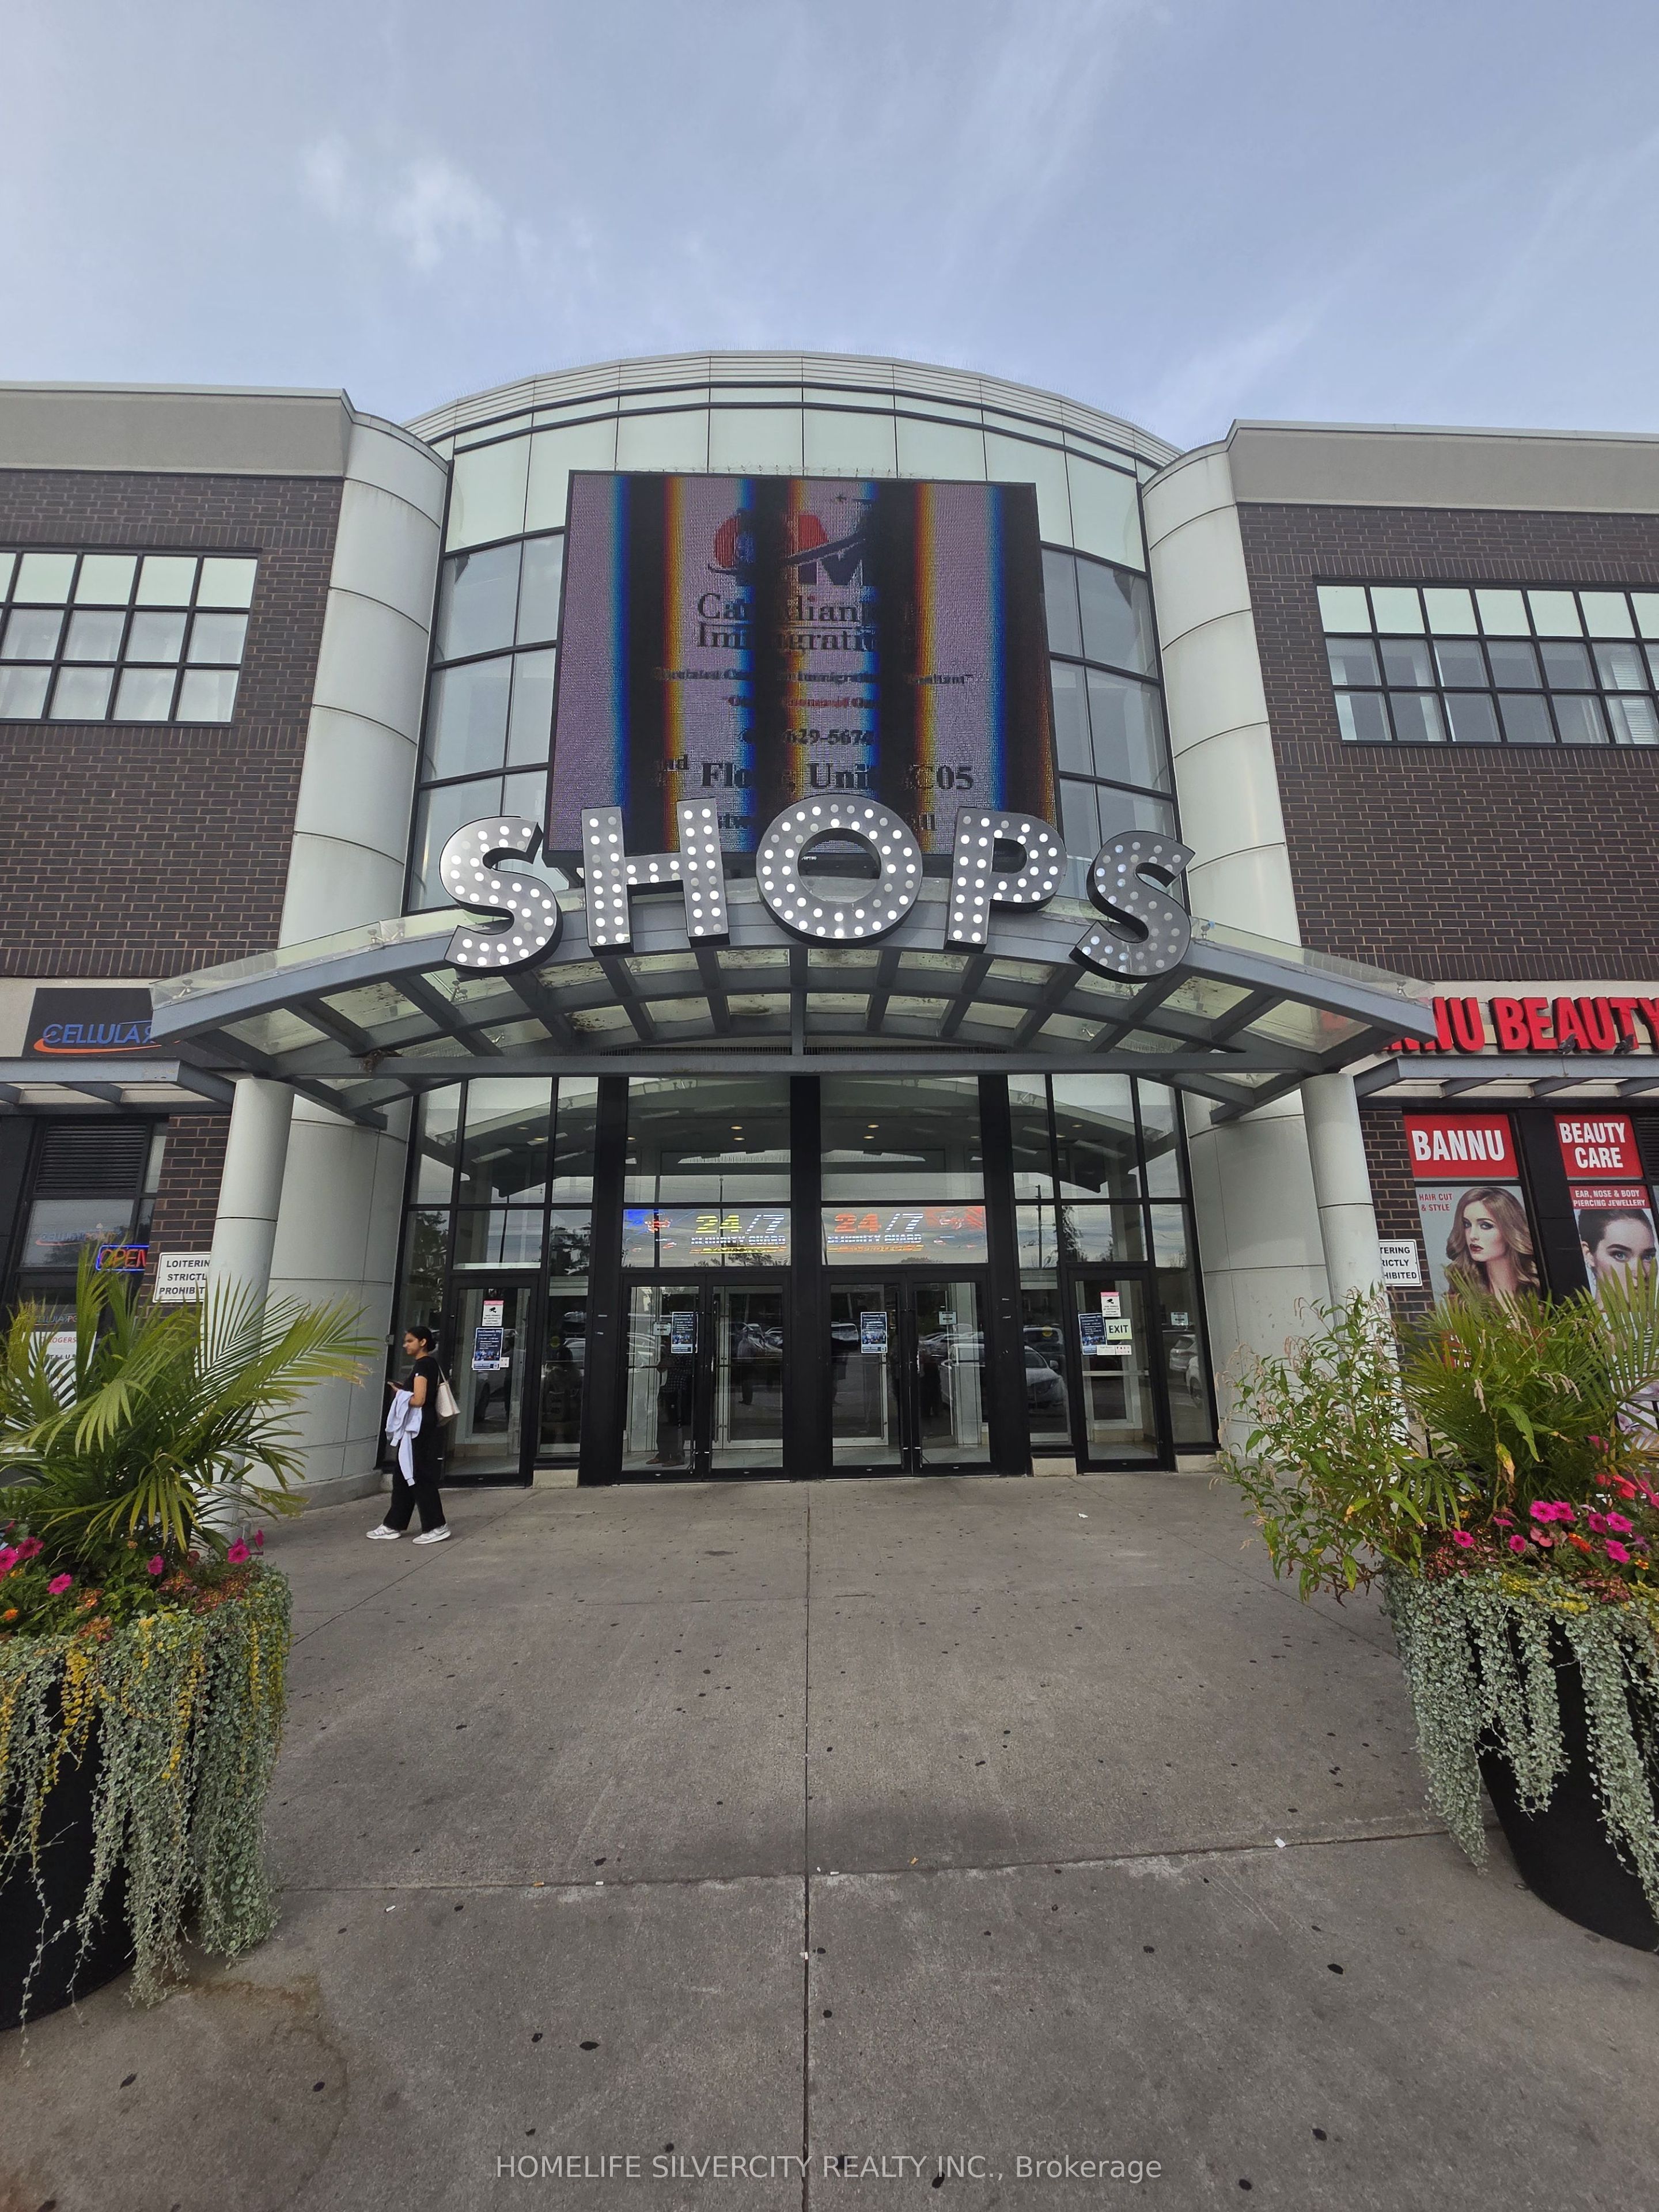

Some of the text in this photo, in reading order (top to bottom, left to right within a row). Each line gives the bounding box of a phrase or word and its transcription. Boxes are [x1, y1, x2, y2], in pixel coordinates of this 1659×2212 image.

[439, 794, 1196, 983] SHOPS
[1559, 1122, 1626, 1143] BEAUTY
[1411, 1130, 1505, 1161] BANNU
[1574, 1146, 1623, 1168] CARE
[1419, 1193, 1453, 1201] HAIR CUT
[1573, 1199, 1646, 1207] PIERCING JEWELLERY
[1574, 1190, 1639, 1199] EAR, NOSE & BODY
[1421, 1203, 1450, 1212] & STYLE
[695, 1214, 785, 1234] 24/7
[834, 1213, 923, 1233] 24/7
[100, 1248, 147, 1268] OPEN
[166, 1260, 210, 1268] LOITERIN
[1108, 1325, 1129, 1334] EXIT
